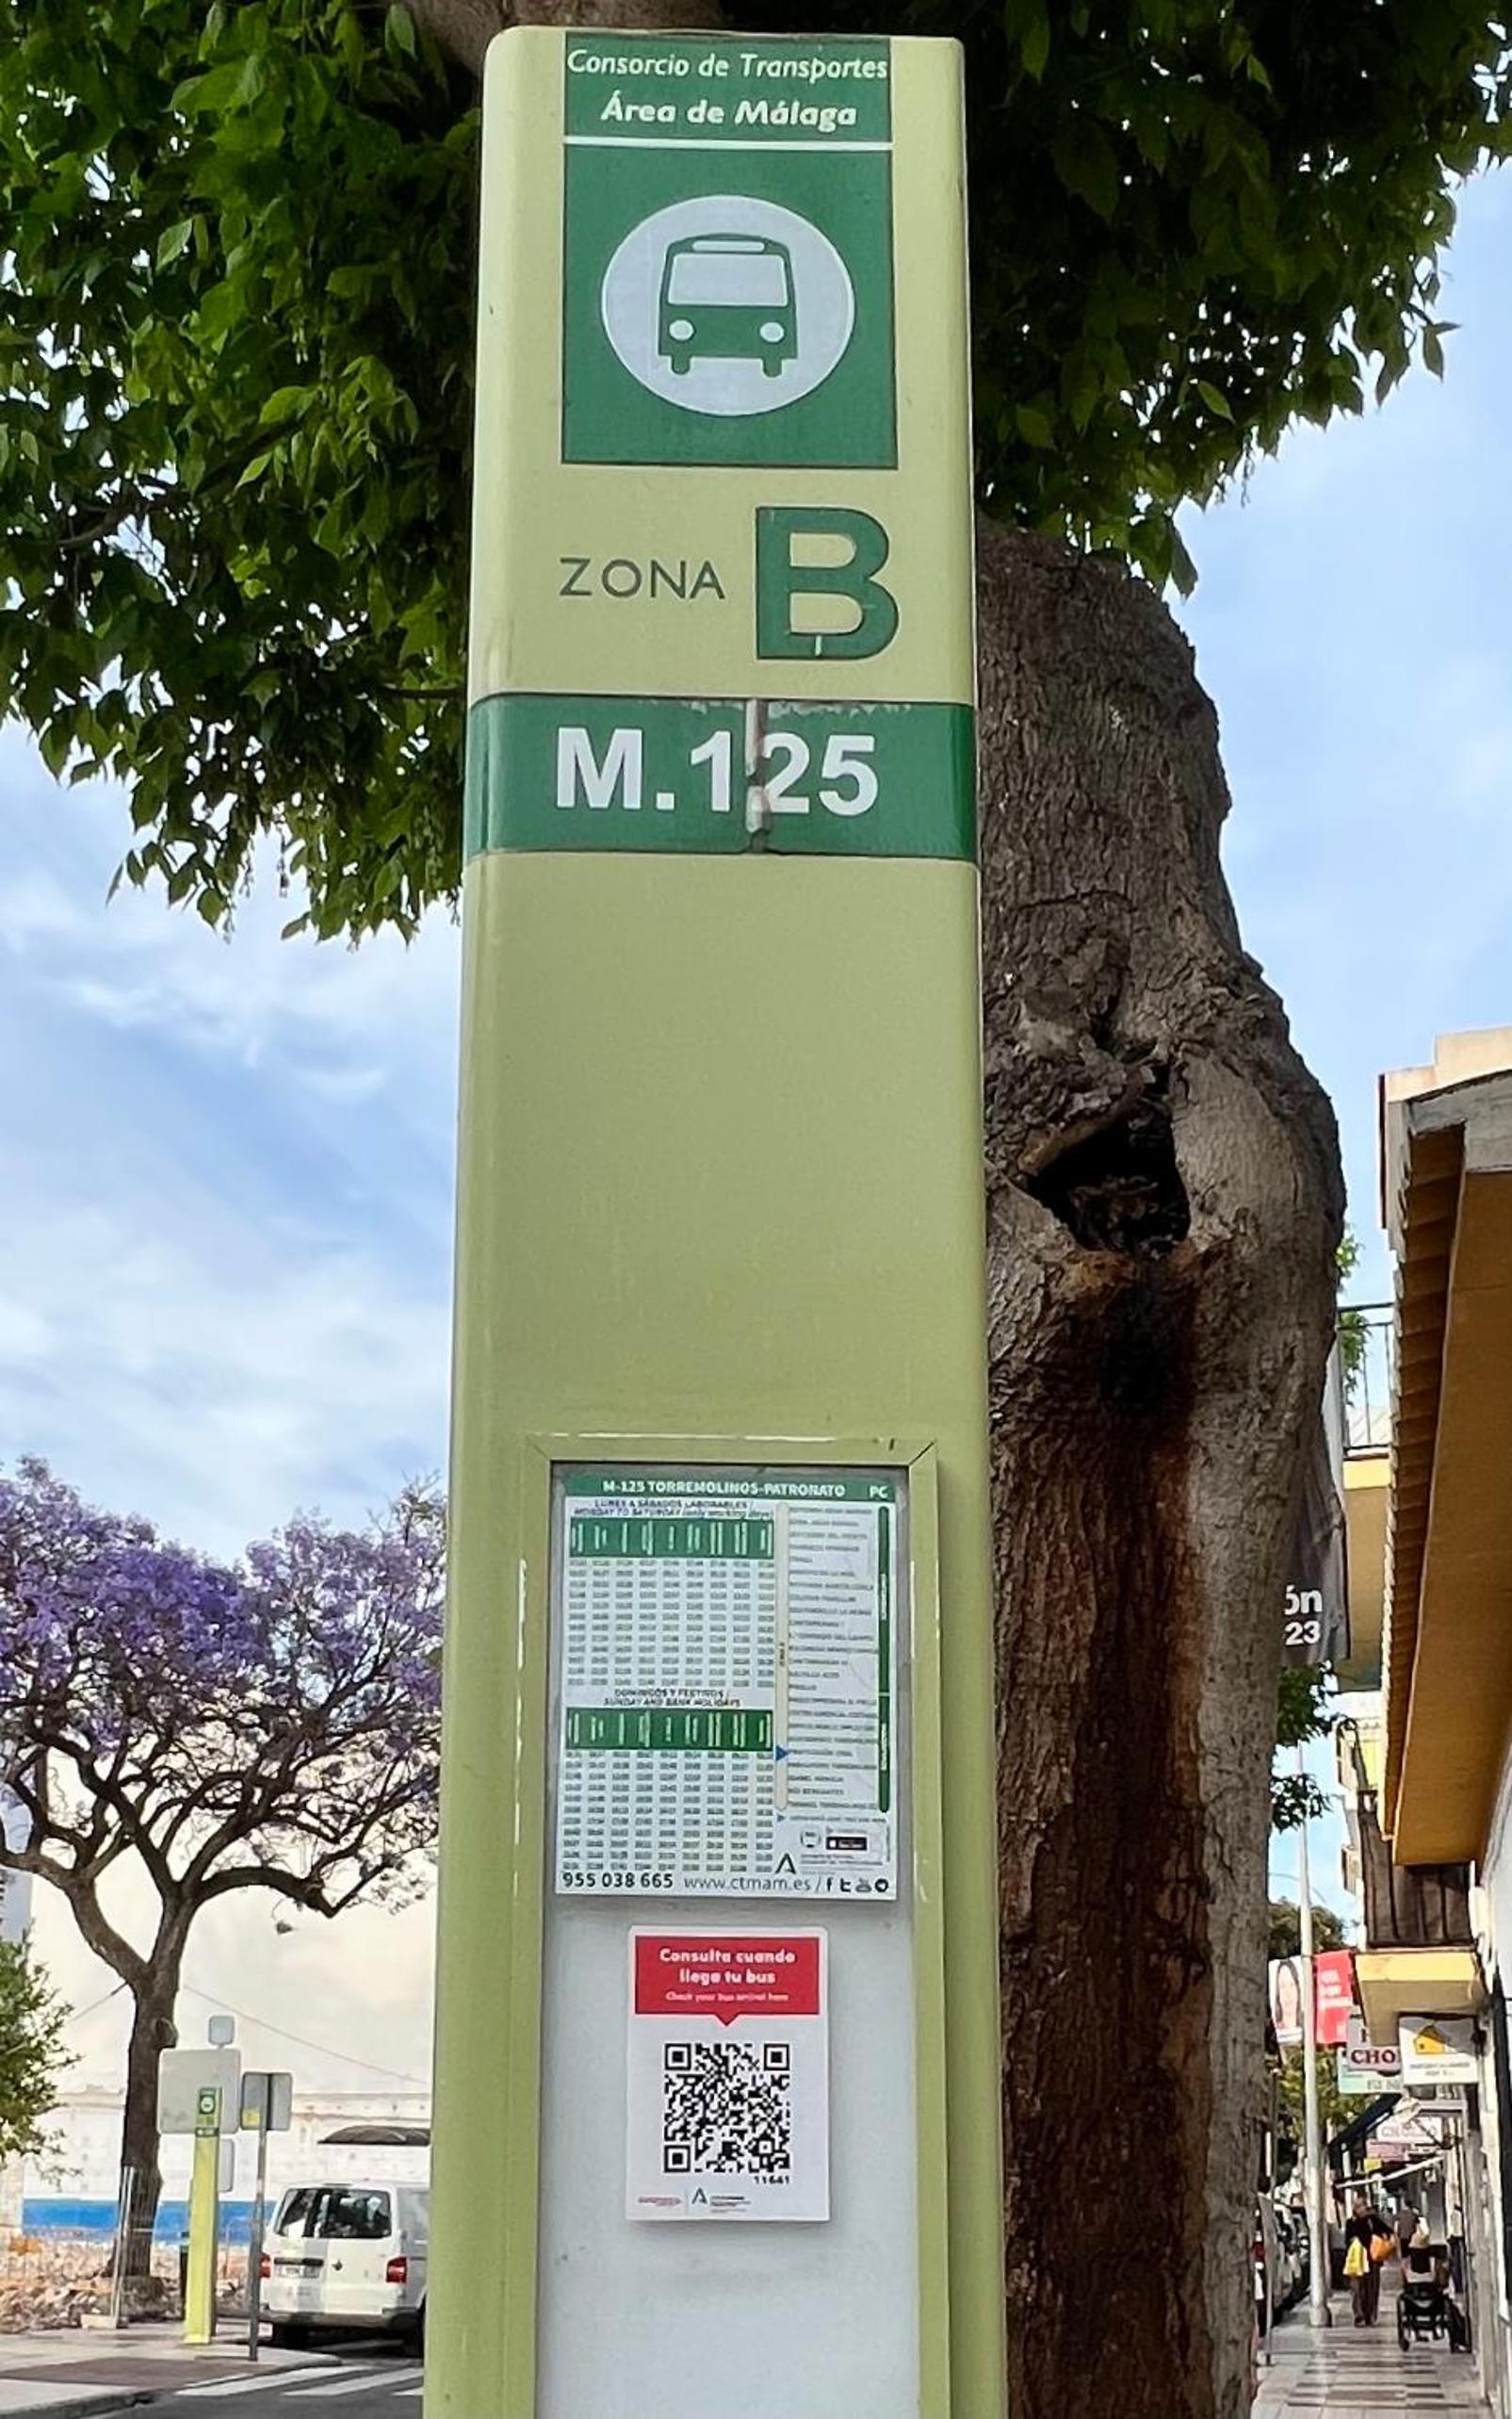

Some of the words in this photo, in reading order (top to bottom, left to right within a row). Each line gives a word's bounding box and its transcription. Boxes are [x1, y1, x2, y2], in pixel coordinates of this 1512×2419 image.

[567, 49, 690, 76] Consorcio
[698, 53, 728, 77] de
[740, 54, 888, 84] Transportes
[600, 90, 676, 123] Área
[687, 100, 724, 124] de
[735, 99, 858, 133] Málaga
[560, 557, 725, 599] ZONA
[756, 506, 899, 660] B
[556, 727, 879, 816] M.125
[603, 1481, 647, 1493] M-125
[648, 1481, 846, 1496] TORREMOLINOS-PATRONATO
[870, 1485, 888, 1498] PC
[562, 1872, 595, 1888] 955
[602, 1872, 635, 1888] 038
[641, 1872, 674, 1888] 665
[659, 1948, 731, 1963] Consulta
[735, 1950, 796, 1964] cuando
[679, 1968, 722, 1985] llega
[724, 1970, 741, 1984] tu
[745, 1969, 776, 1984] bus
[755, 2175, 790, 2185] 11641
